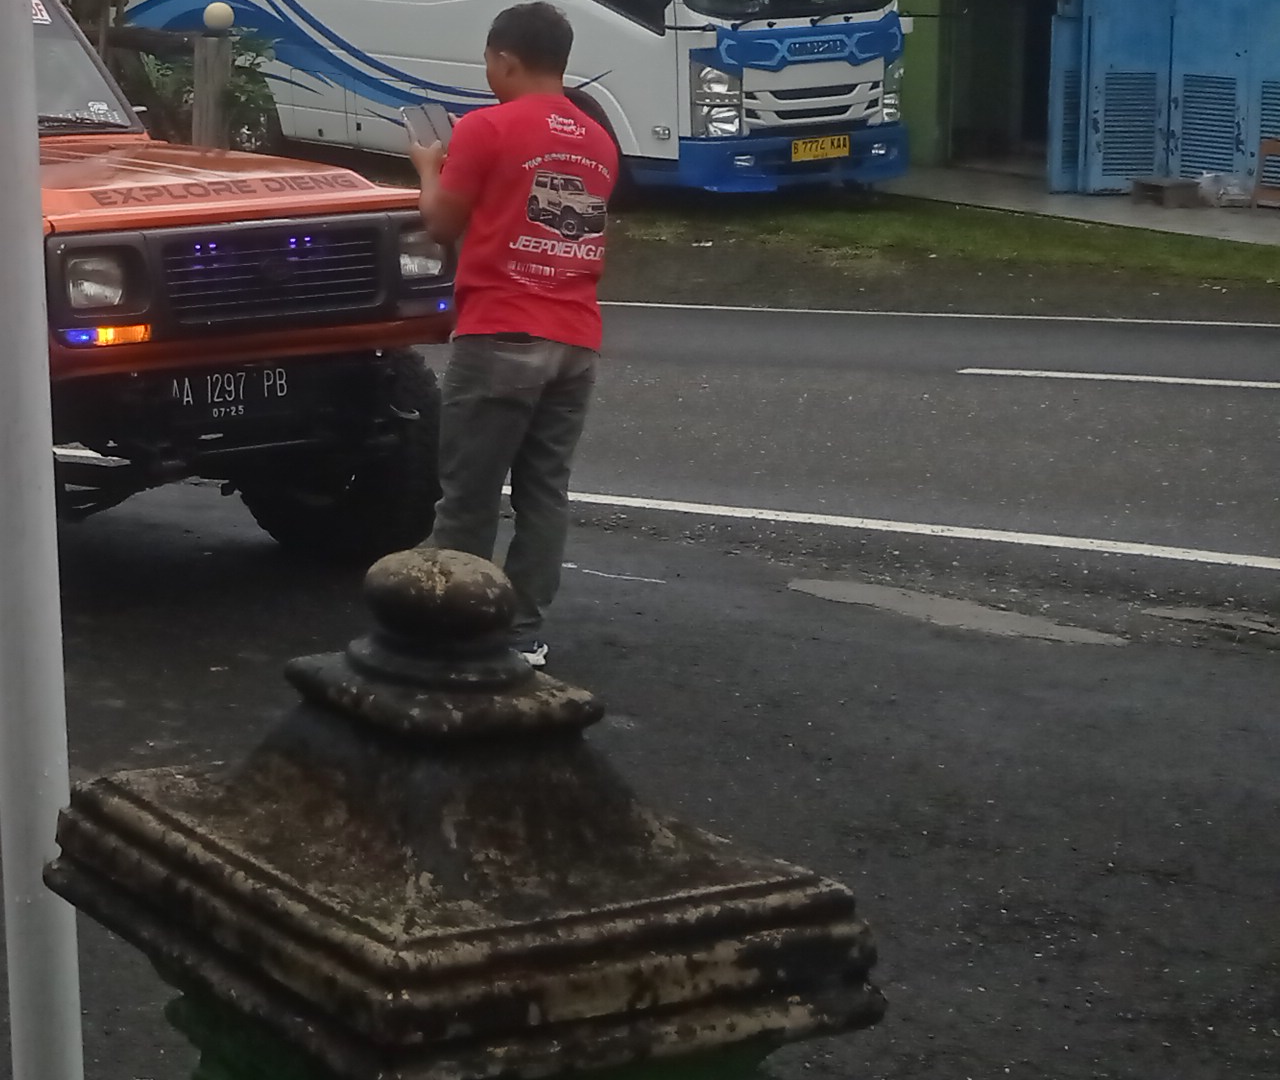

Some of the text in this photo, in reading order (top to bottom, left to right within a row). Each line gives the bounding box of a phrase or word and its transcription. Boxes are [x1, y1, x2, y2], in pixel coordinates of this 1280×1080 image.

[90, 173, 359, 207] EXPLORE DIENG
[207, 371, 246, 403] 1297
[263, 368, 288, 398] PB
